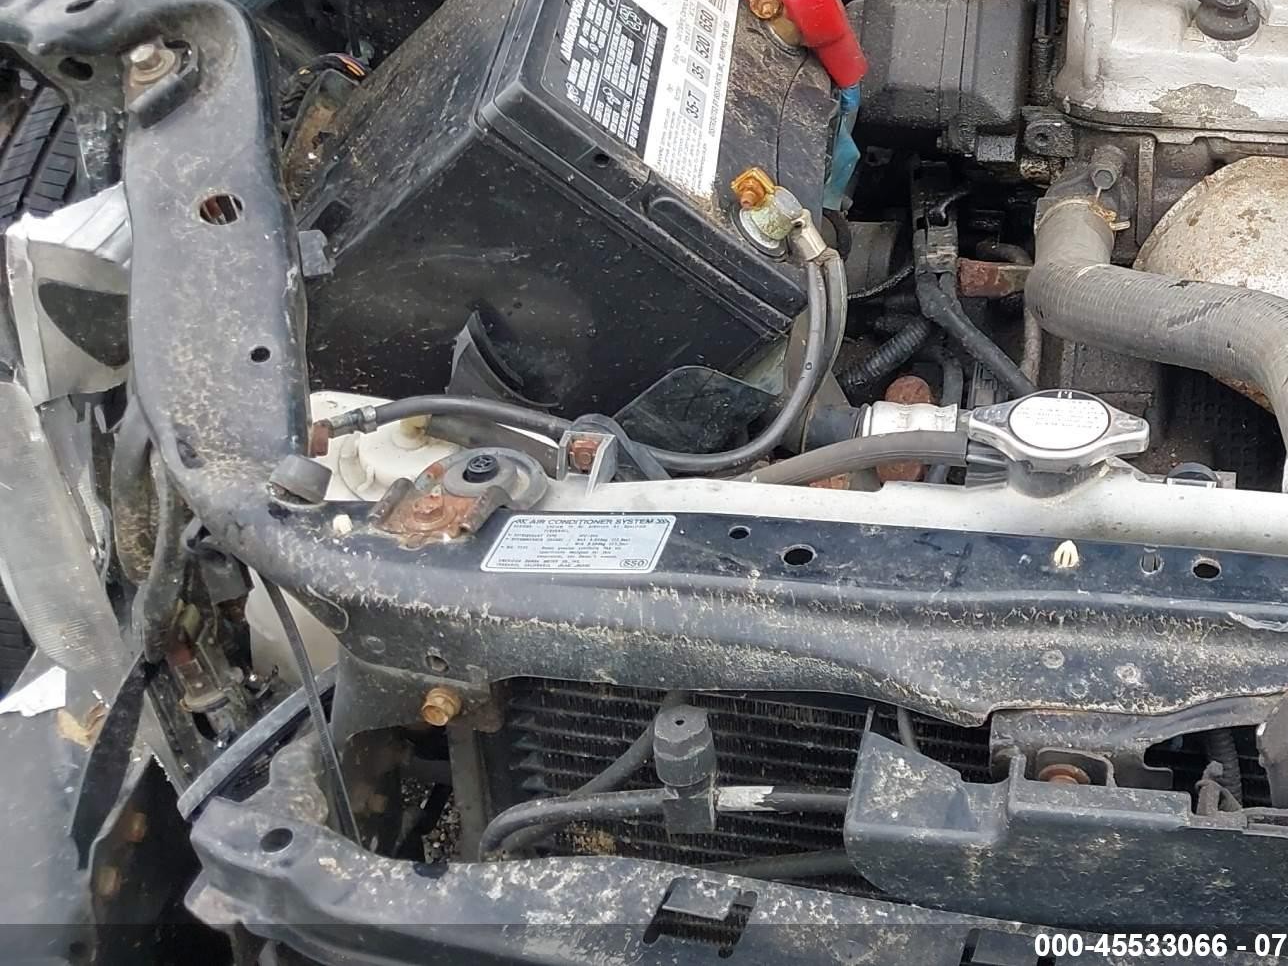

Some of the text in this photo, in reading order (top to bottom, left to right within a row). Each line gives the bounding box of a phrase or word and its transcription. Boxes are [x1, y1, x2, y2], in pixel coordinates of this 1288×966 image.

[698, 7, 713, 34] 650
[695, 33, 710, 60] 520
[691, 61, 704, 81] 35
[686, 91, 700, 119] 35-T
